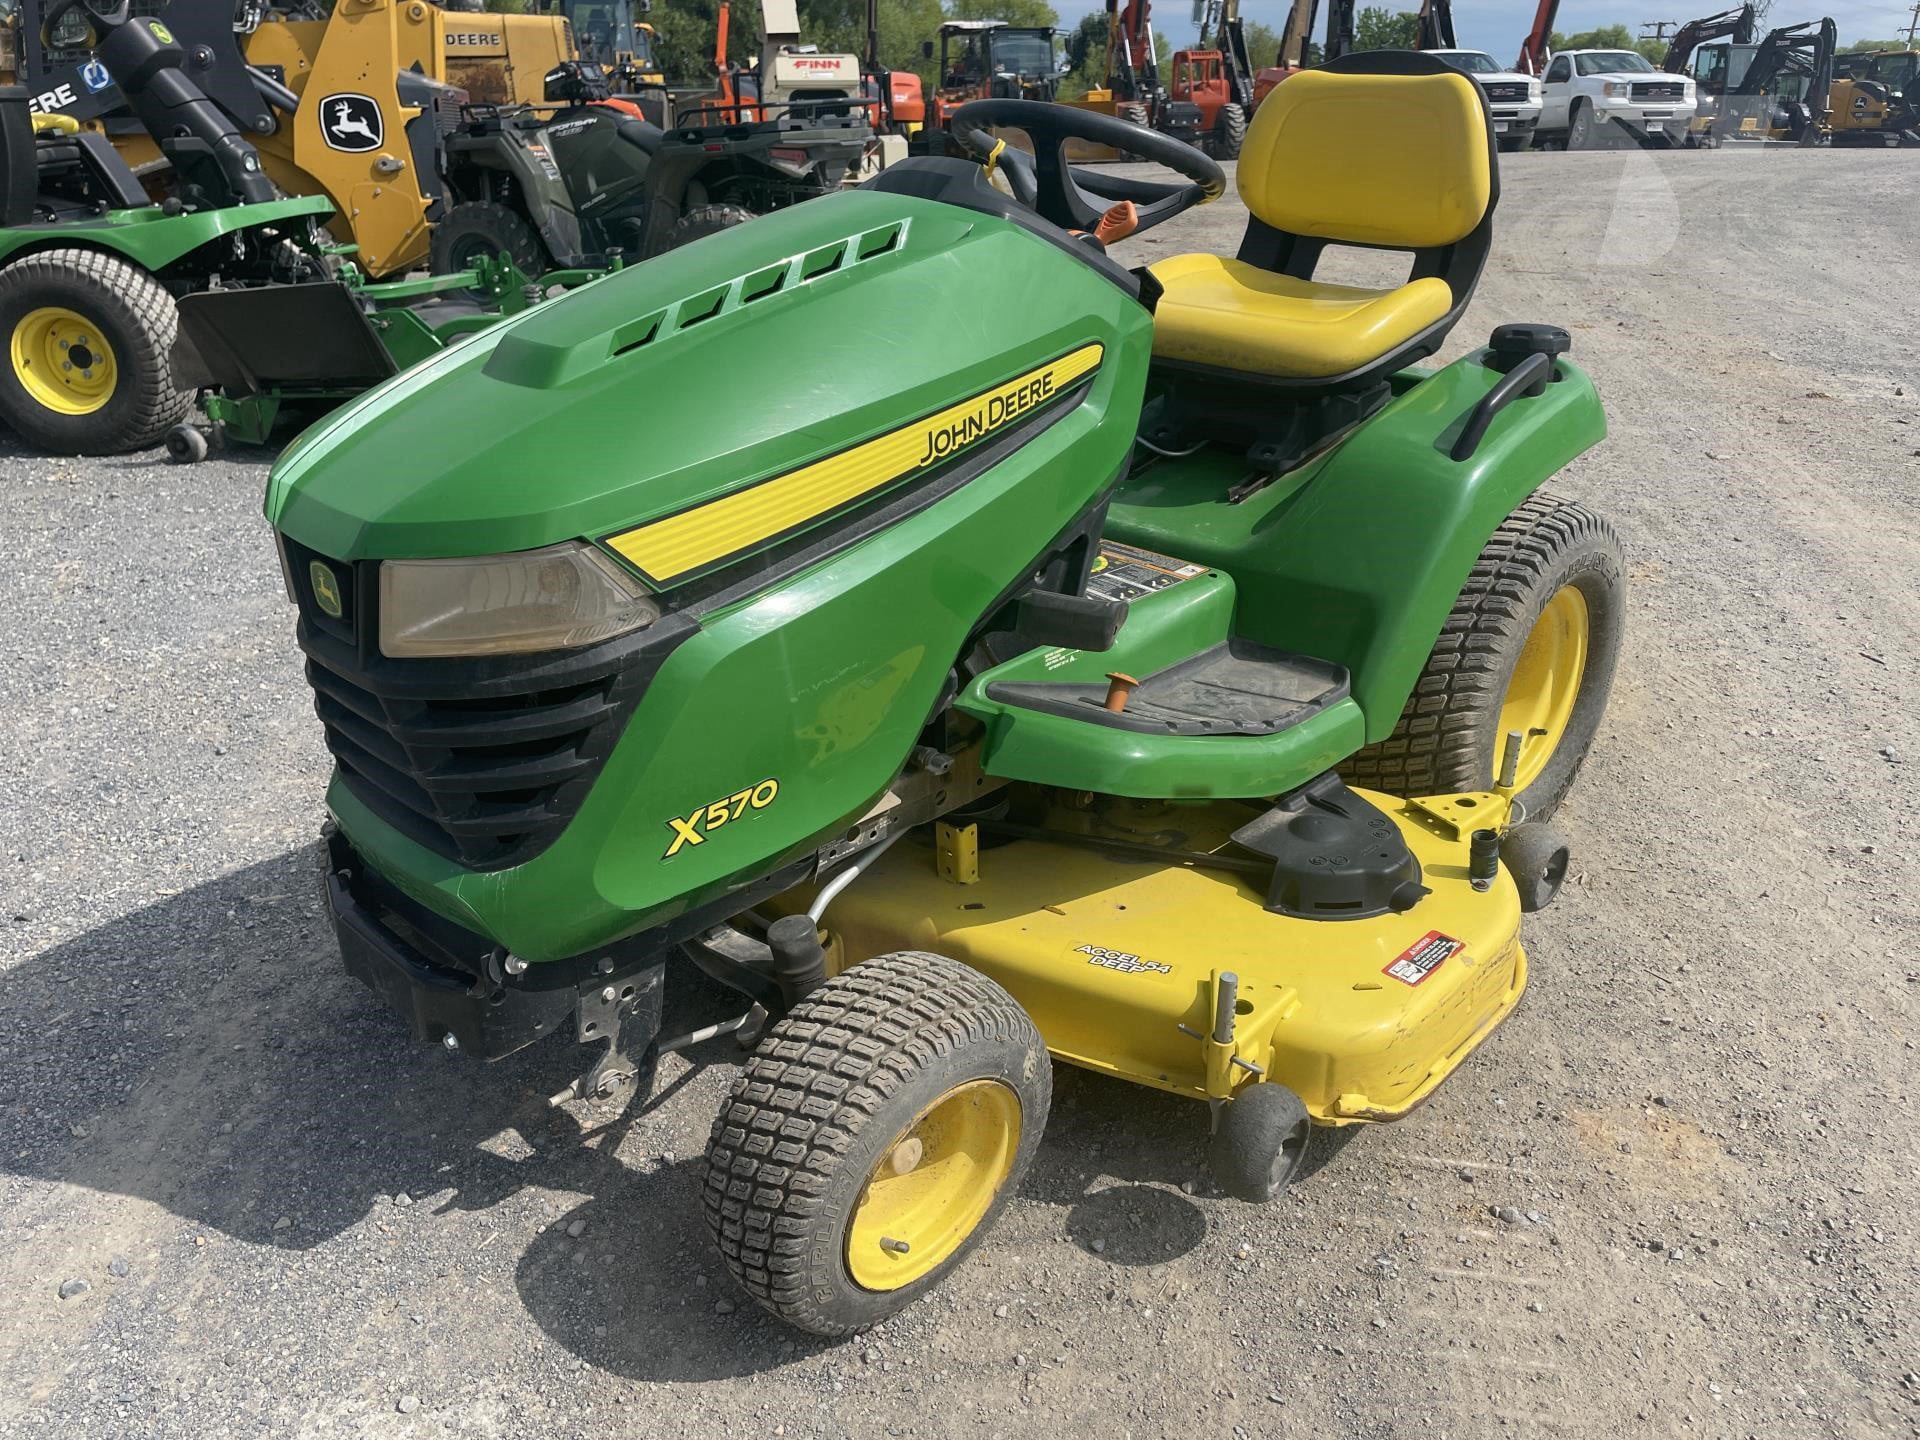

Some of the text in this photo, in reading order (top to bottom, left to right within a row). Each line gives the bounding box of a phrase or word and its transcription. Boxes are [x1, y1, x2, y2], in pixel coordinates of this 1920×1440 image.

[445, 34, 500, 46] DEERE
[793, 60, 840, 69] FINN
[920, 370, 1055, 465] JOHN DEERE
[661, 778, 780, 860] X570
[1073, 944, 1172, 974] ACCEL 54
[1088, 955, 1145, 973] DEEP
